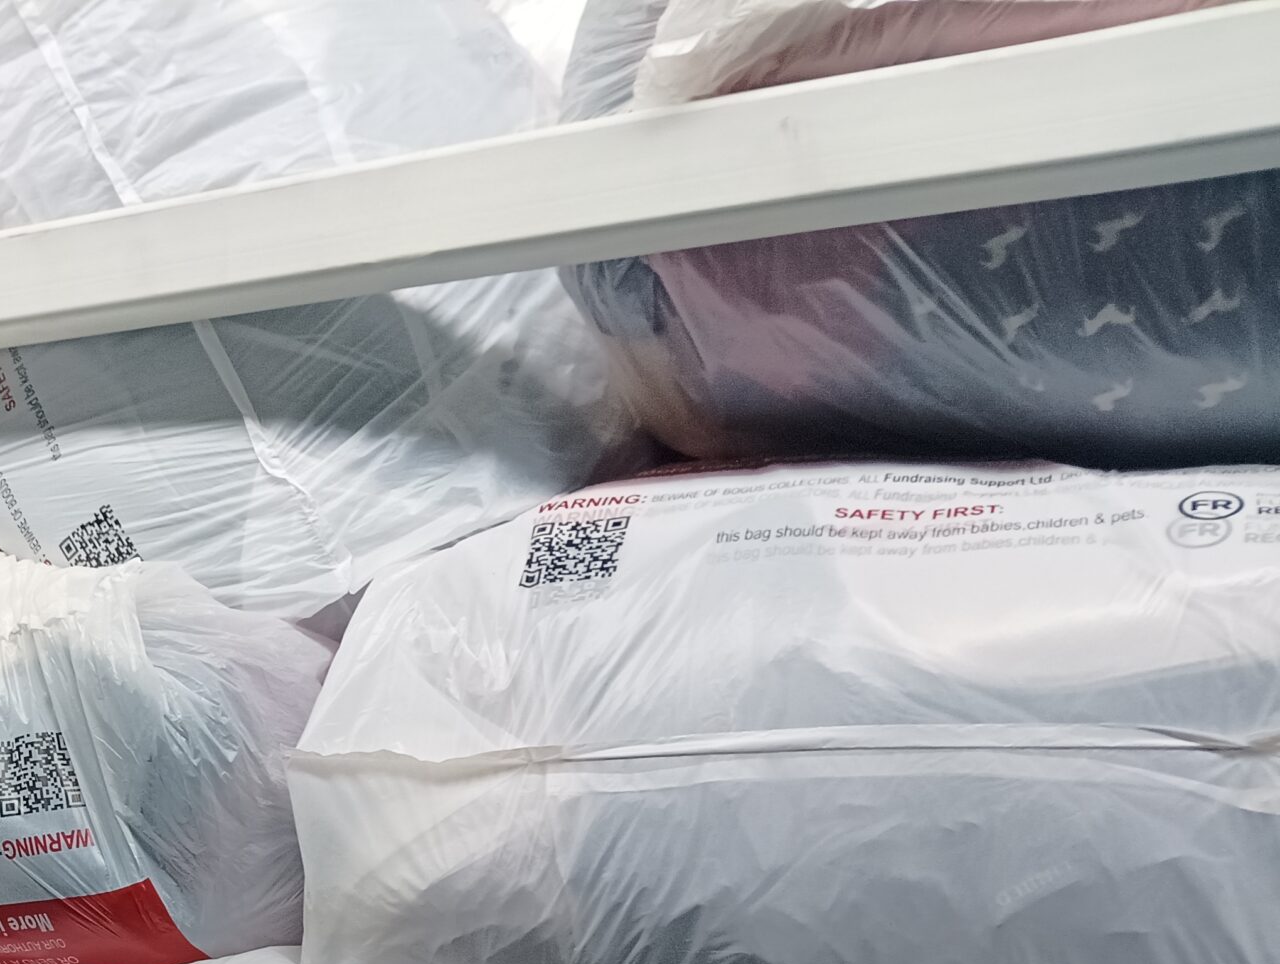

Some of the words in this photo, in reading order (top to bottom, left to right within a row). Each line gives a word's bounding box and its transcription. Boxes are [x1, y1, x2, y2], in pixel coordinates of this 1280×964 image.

[537, 494, 648, 514] WARNING:
[704, 487, 719, 498] OF
[883, 472, 965, 486] Fundraising
[970, 477, 1026, 488] Support
[10, 508, 23, 522] OF
[834, 507, 925, 521] SAFETY
[931, 504, 1005, 520] FIRST:
[1190, 499, 1233, 512] FR
[17, 517, 42, 554] BEWARE
[716, 529, 741, 544] this
[743, 528, 772, 542] bag
[775, 524, 825, 539] should
[827, 525, 848, 538] be
[851, 526, 883, 541] kept
[886, 527, 926, 542] away
[931, 524, 967, 538] from
[969, 516, 1089, 535] babies,children
[1094, 512, 1105, 525] &
[8, 912, 55, 933] More
